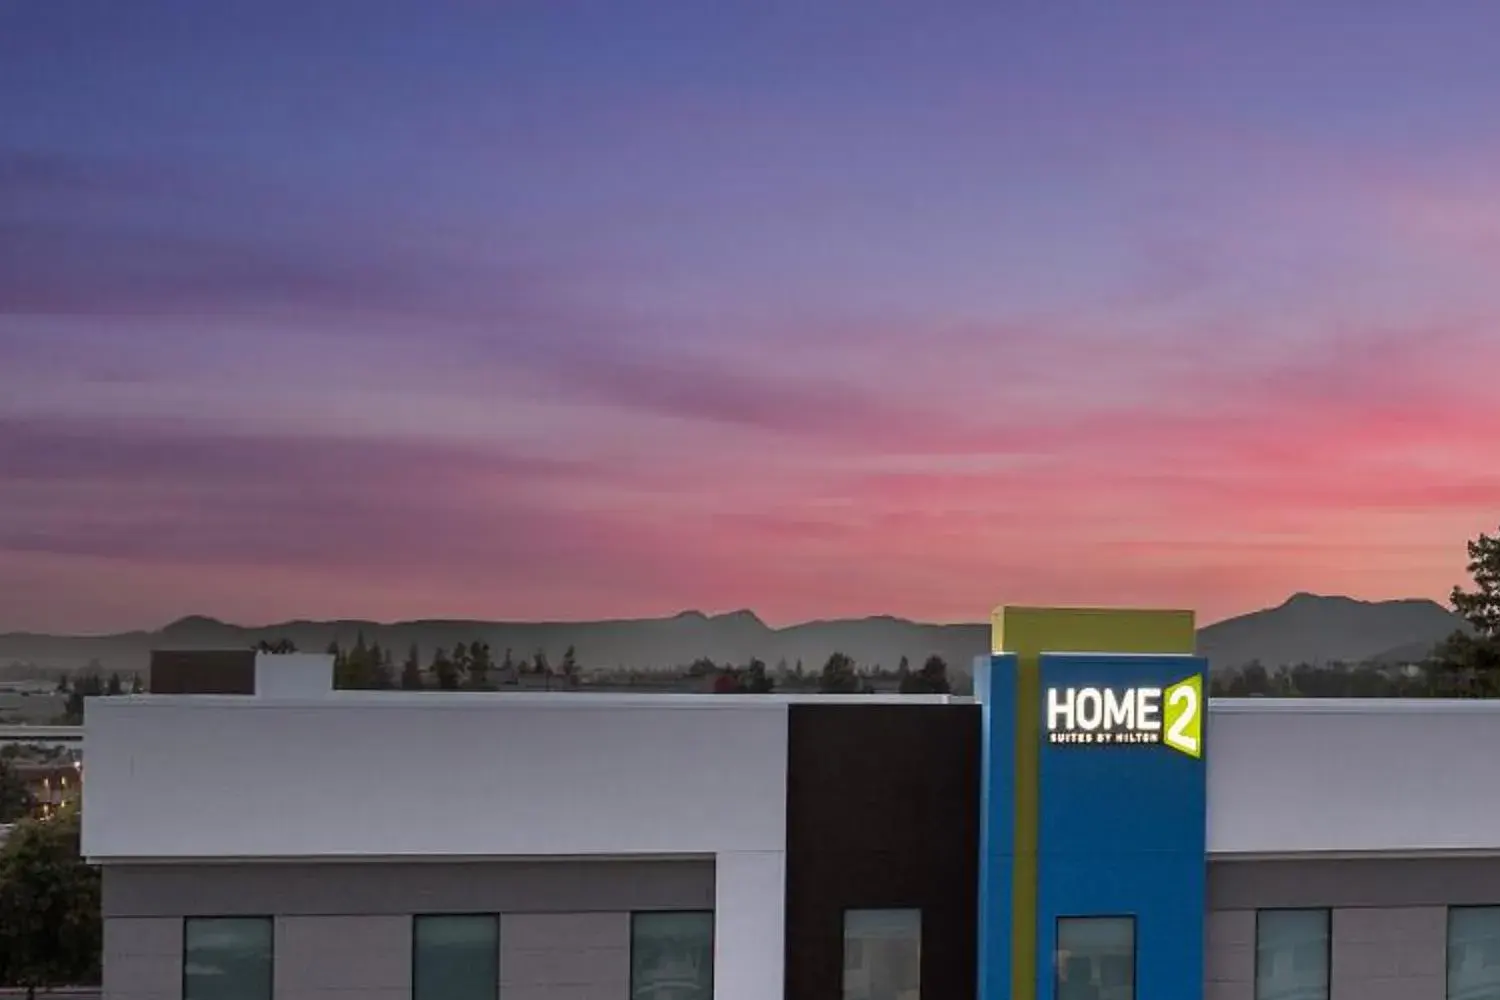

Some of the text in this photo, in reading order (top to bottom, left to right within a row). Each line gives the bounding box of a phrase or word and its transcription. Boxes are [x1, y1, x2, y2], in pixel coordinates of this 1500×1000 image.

[1050, 732, 1159, 743] SUITES BY HILTON
